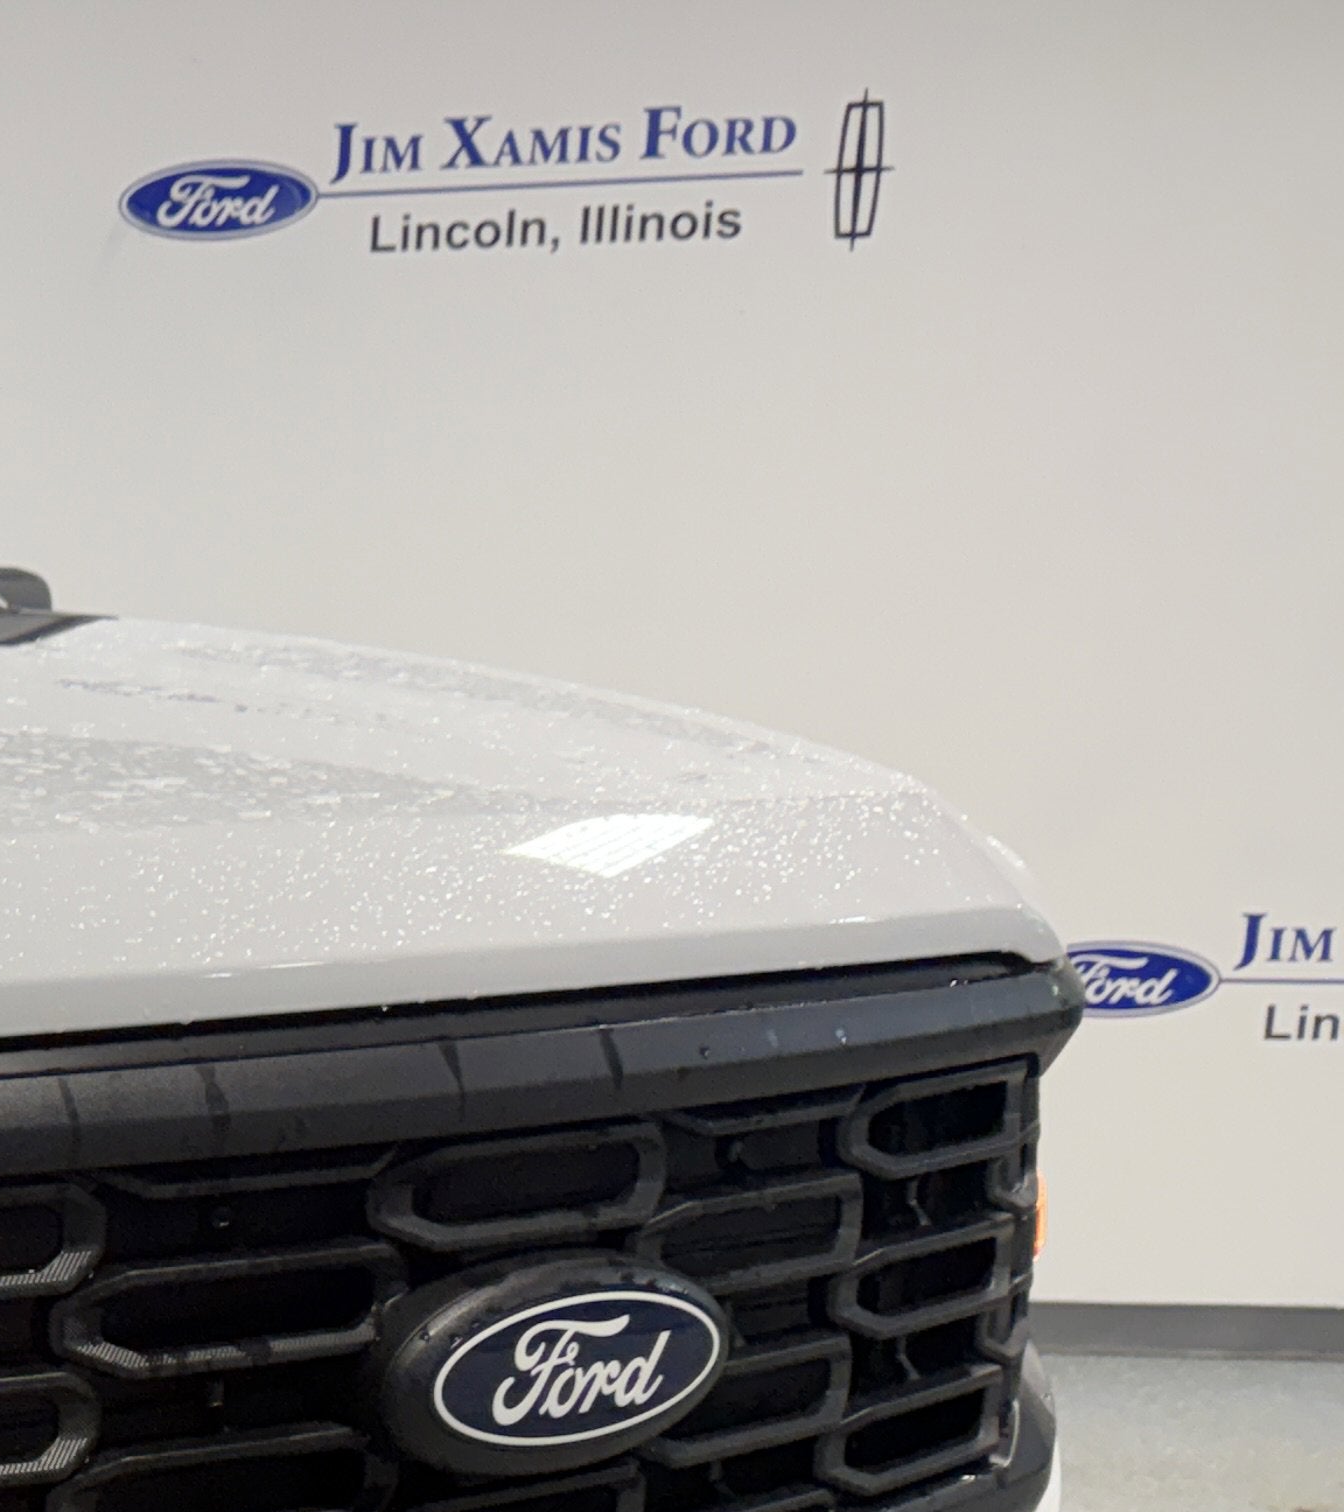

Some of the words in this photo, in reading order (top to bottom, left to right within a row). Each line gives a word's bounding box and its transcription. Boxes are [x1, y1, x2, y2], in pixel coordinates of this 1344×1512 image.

[329, 122, 422, 184] JIM
[440, 113, 622, 170] XAMIS
[640, 105, 798, 159] FORD
[155, 174, 277, 229] Ford
[370, 207, 560, 254] Lincoln,
[579, 205, 743, 245] Illinois
[1233, 911, 1337, 971] JIM
[1263, 1003, 1340, 1041] Lin
[492, 1313, 671, 1426] Ford
